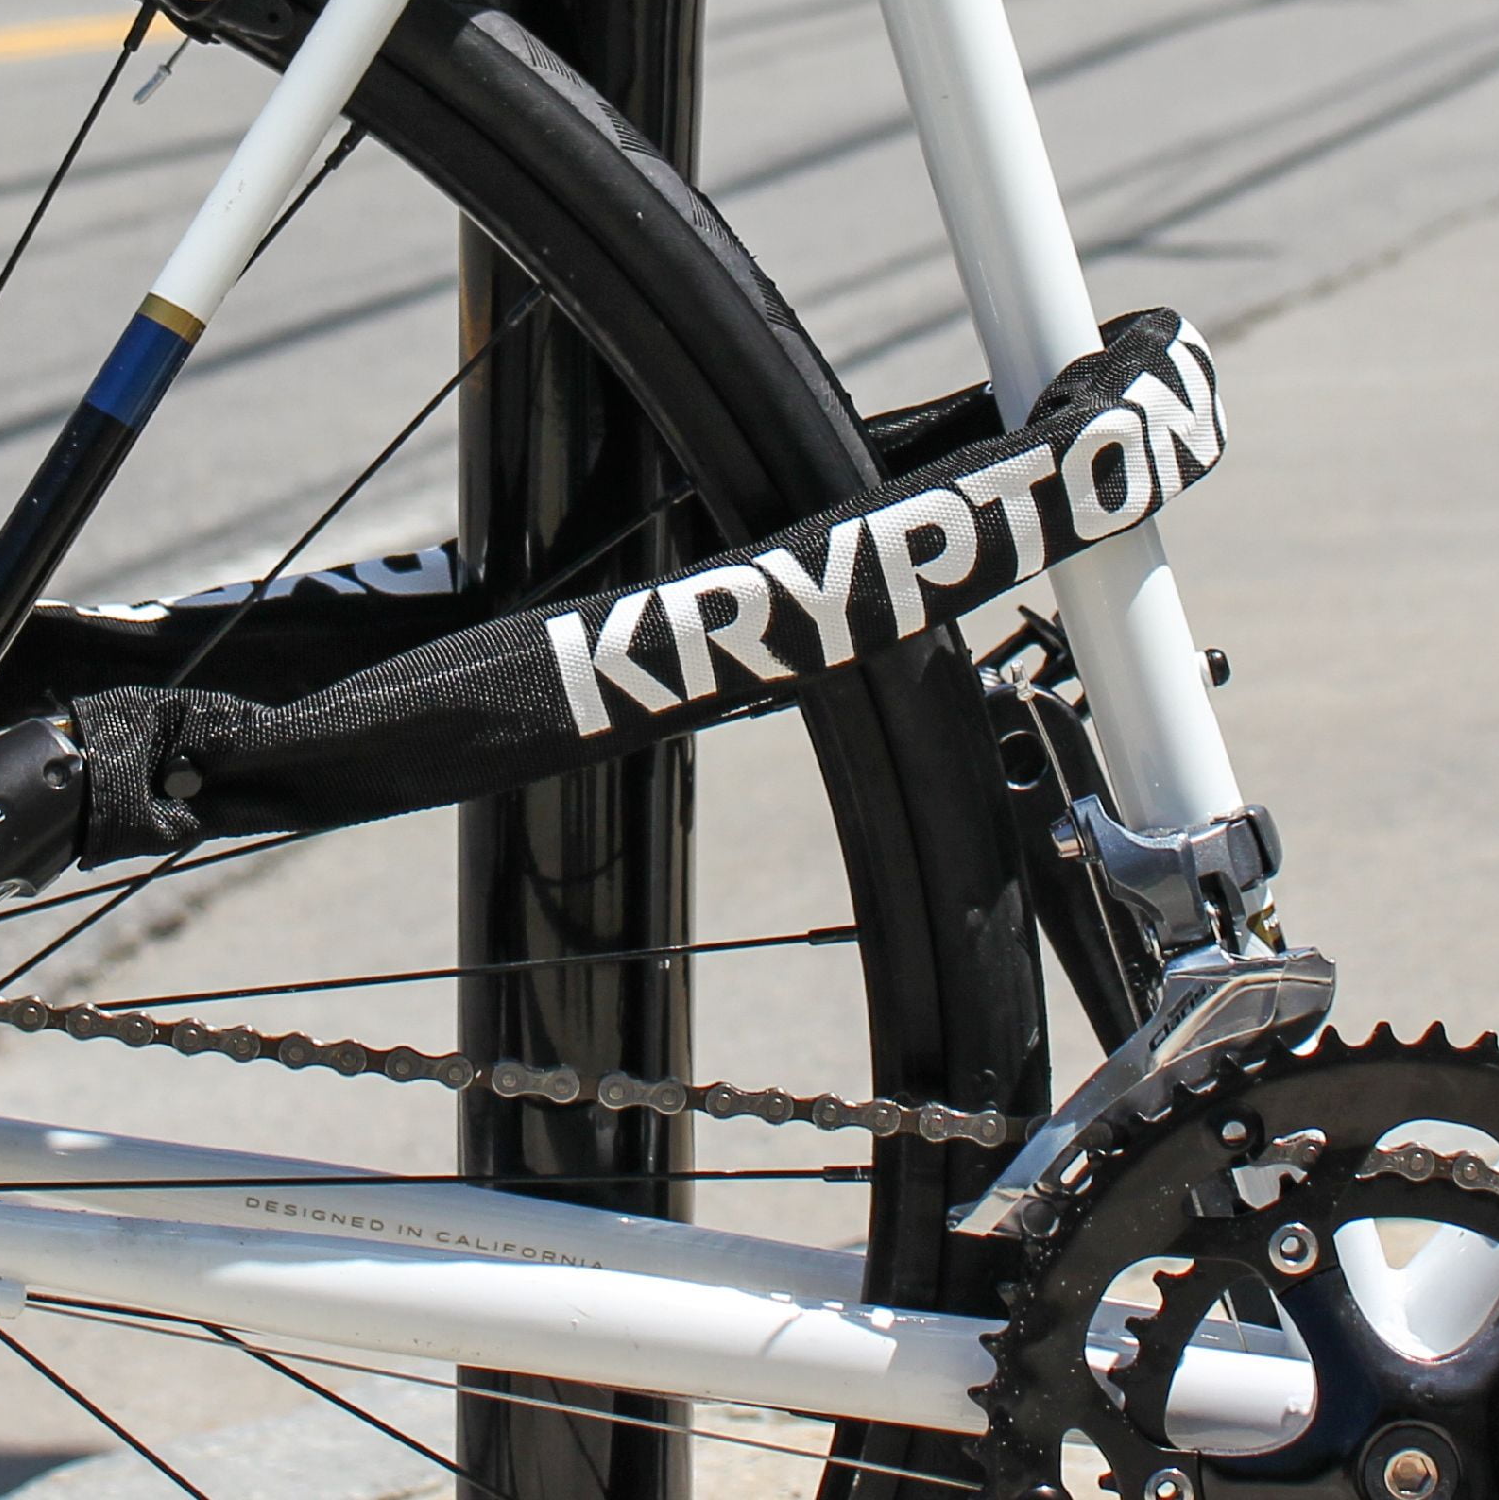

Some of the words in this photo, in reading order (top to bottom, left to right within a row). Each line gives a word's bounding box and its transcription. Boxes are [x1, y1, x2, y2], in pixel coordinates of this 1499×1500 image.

[245, 1196, 385, 1233] DESIGNED
[398, 1223, 424, 1239] IN
[436, 1231, 604, 1270] CALIFORNIA
